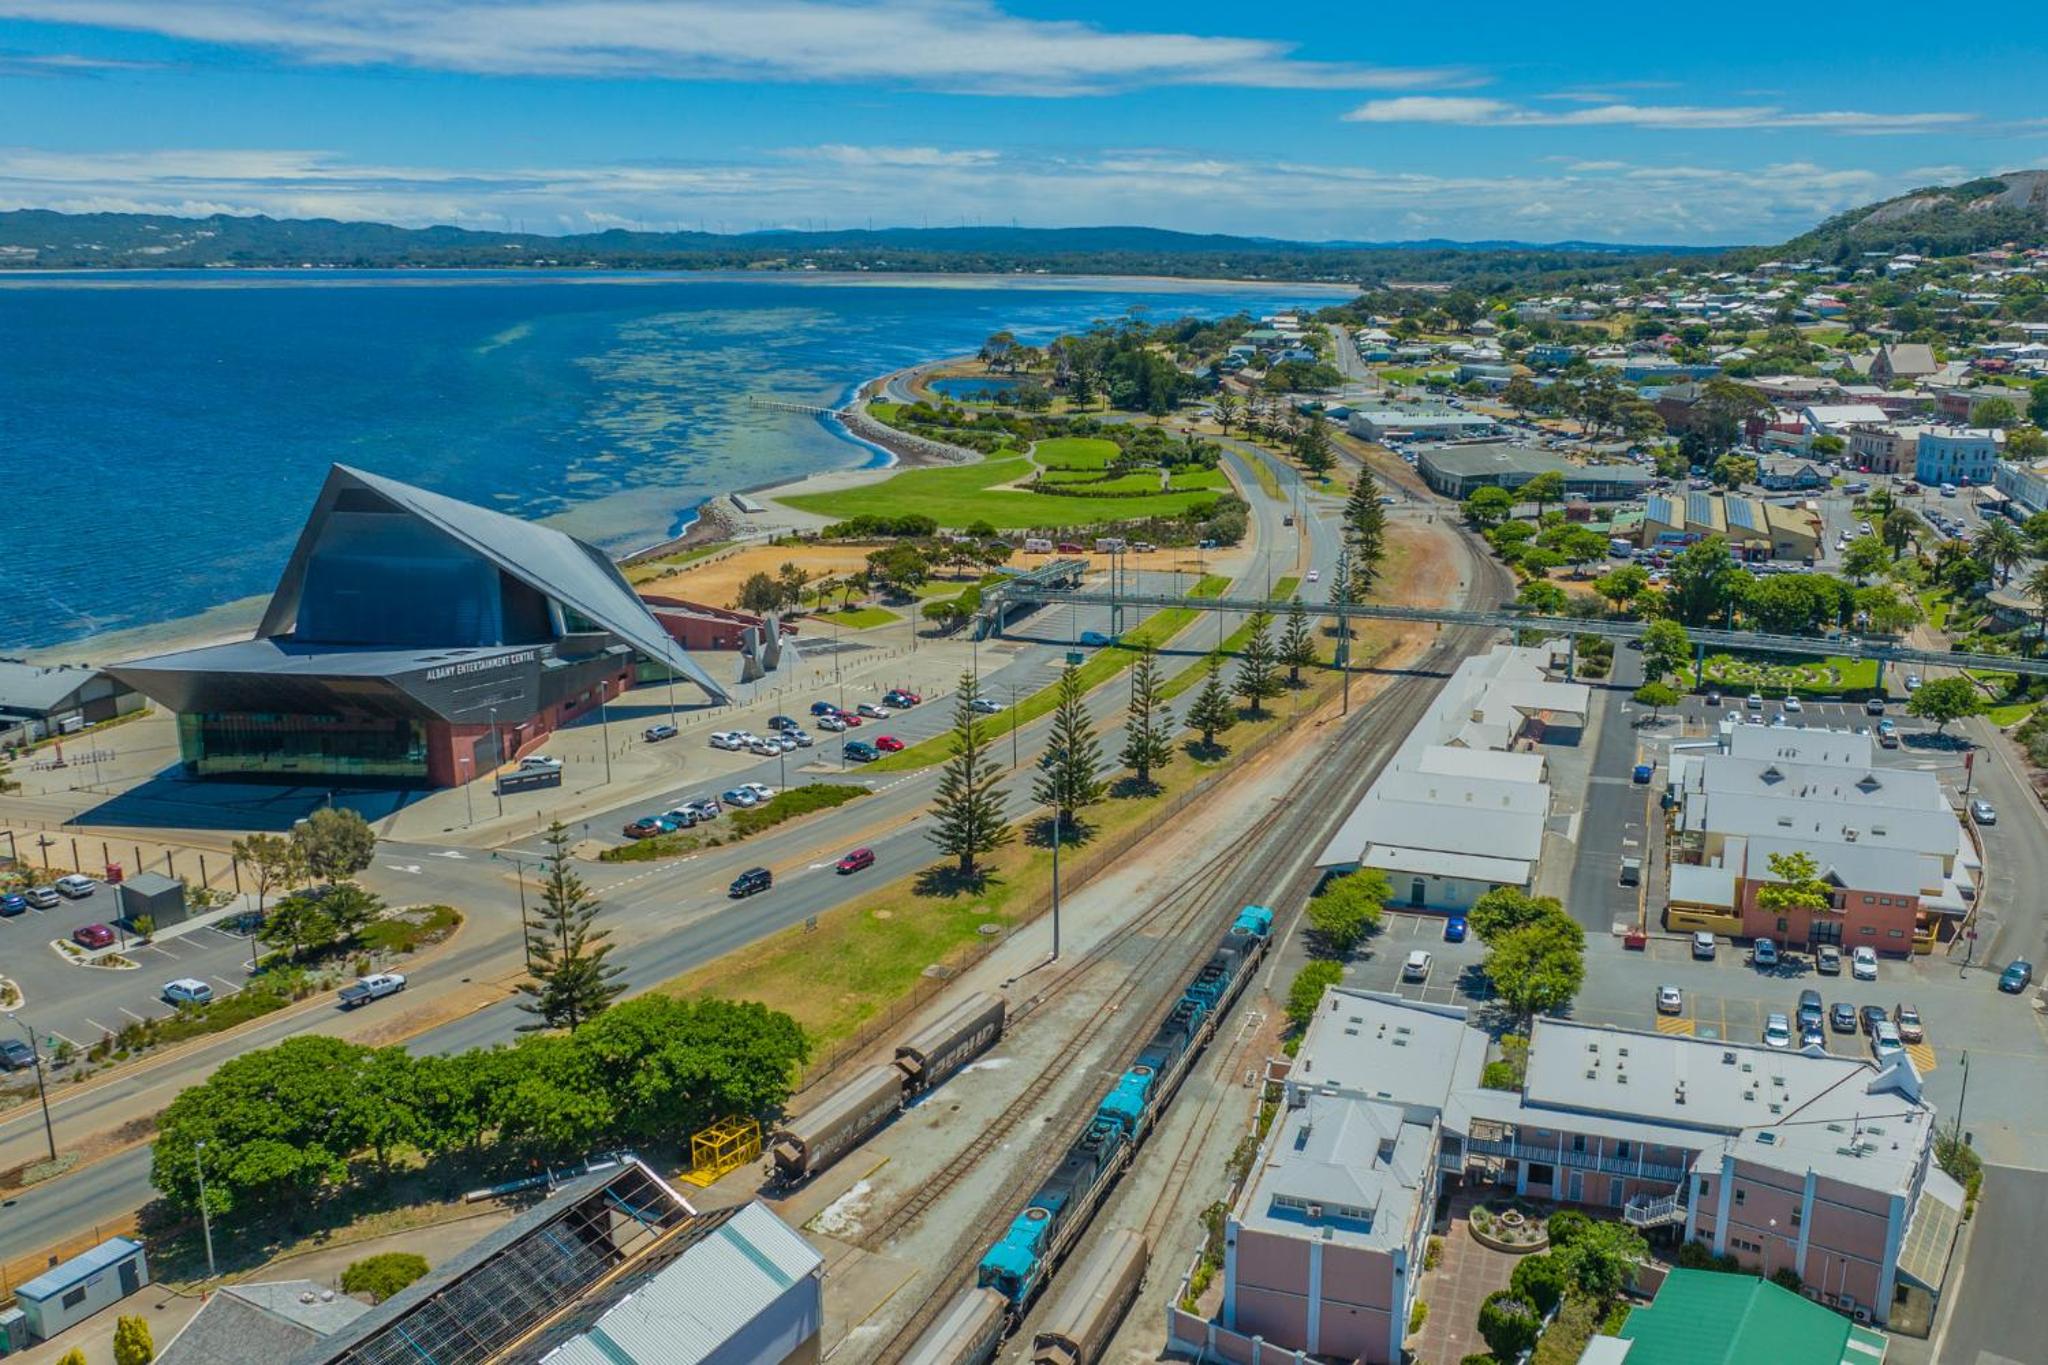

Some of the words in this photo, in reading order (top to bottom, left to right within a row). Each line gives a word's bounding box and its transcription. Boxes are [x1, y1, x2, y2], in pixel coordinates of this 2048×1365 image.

[427, 666, 455, 680] ALBANY
[457, 656, 509, 674] ENTERTAINMENT
[511, 650, 535, 664] CENTRE
